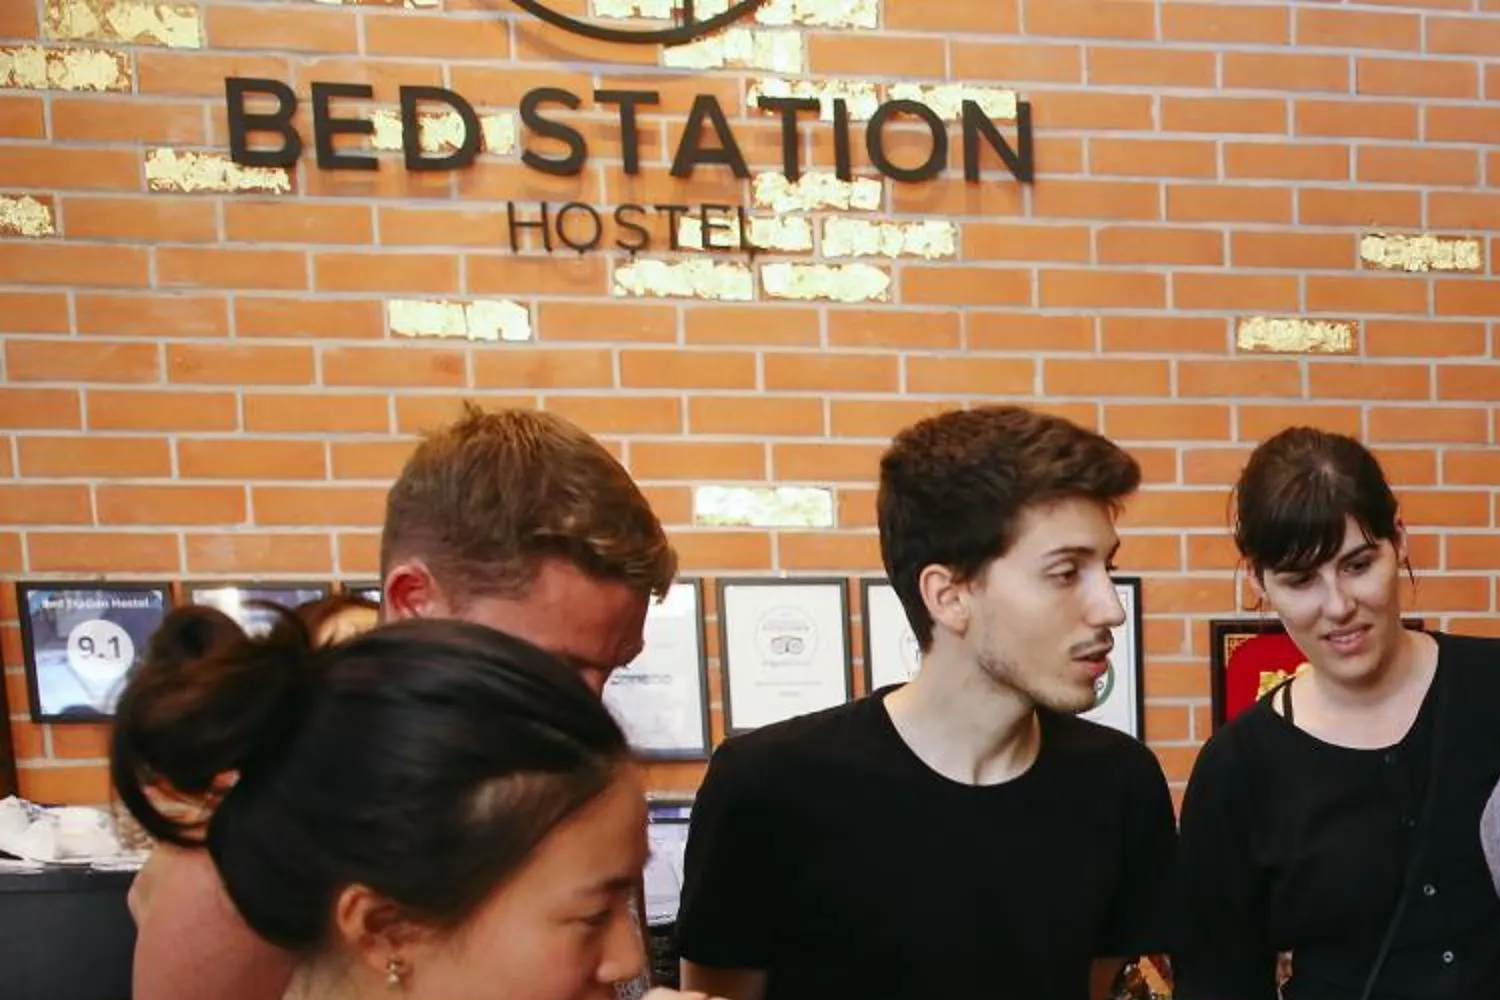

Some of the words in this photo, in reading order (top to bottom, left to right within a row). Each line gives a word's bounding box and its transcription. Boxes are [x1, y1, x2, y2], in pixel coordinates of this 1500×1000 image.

[225, 77, 481, 171] BED
[520, 88, 1034, 184] STATION
[507, 201, 768, 253] HOSTEL
[78, 635, 121, 659] 9.1
